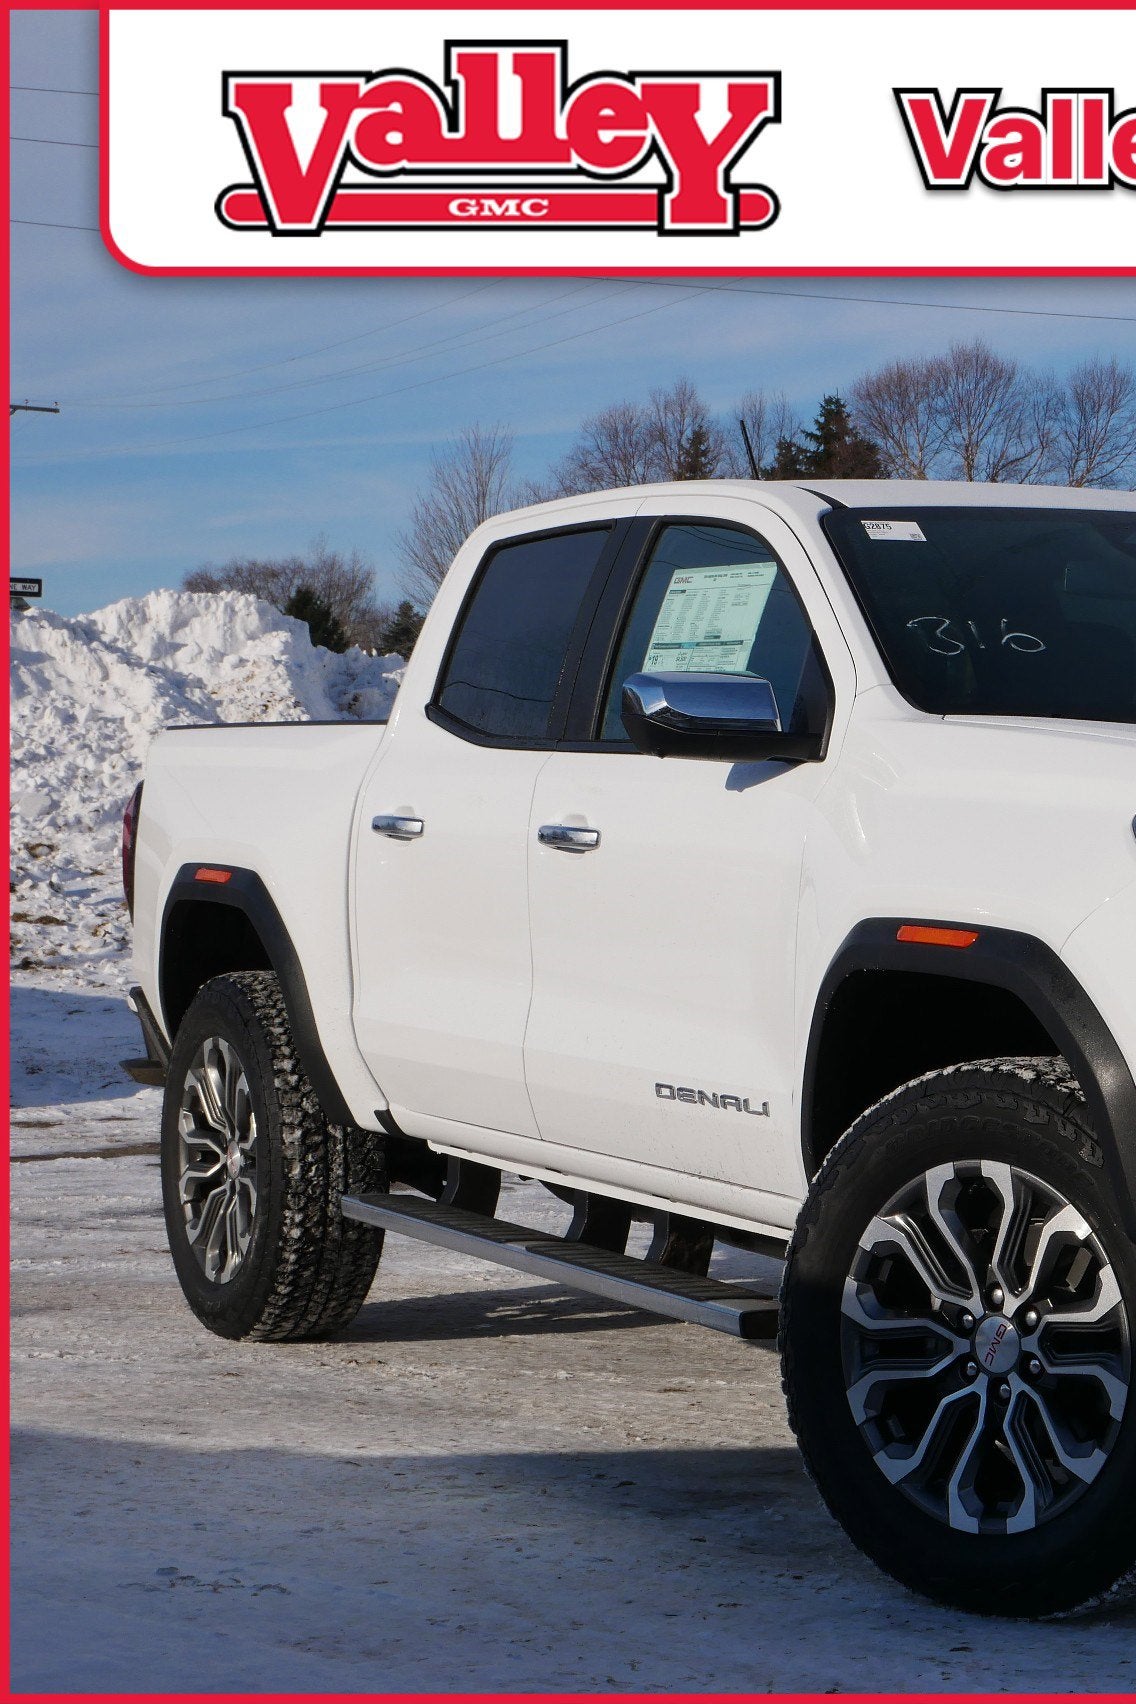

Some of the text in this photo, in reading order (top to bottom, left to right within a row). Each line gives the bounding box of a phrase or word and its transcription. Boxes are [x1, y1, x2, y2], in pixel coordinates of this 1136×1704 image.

[906, 616, 1046, 655] 316
[655, 1082, 770, 1117] DENALI
[985, 1323, 1007, 1366] GMC
